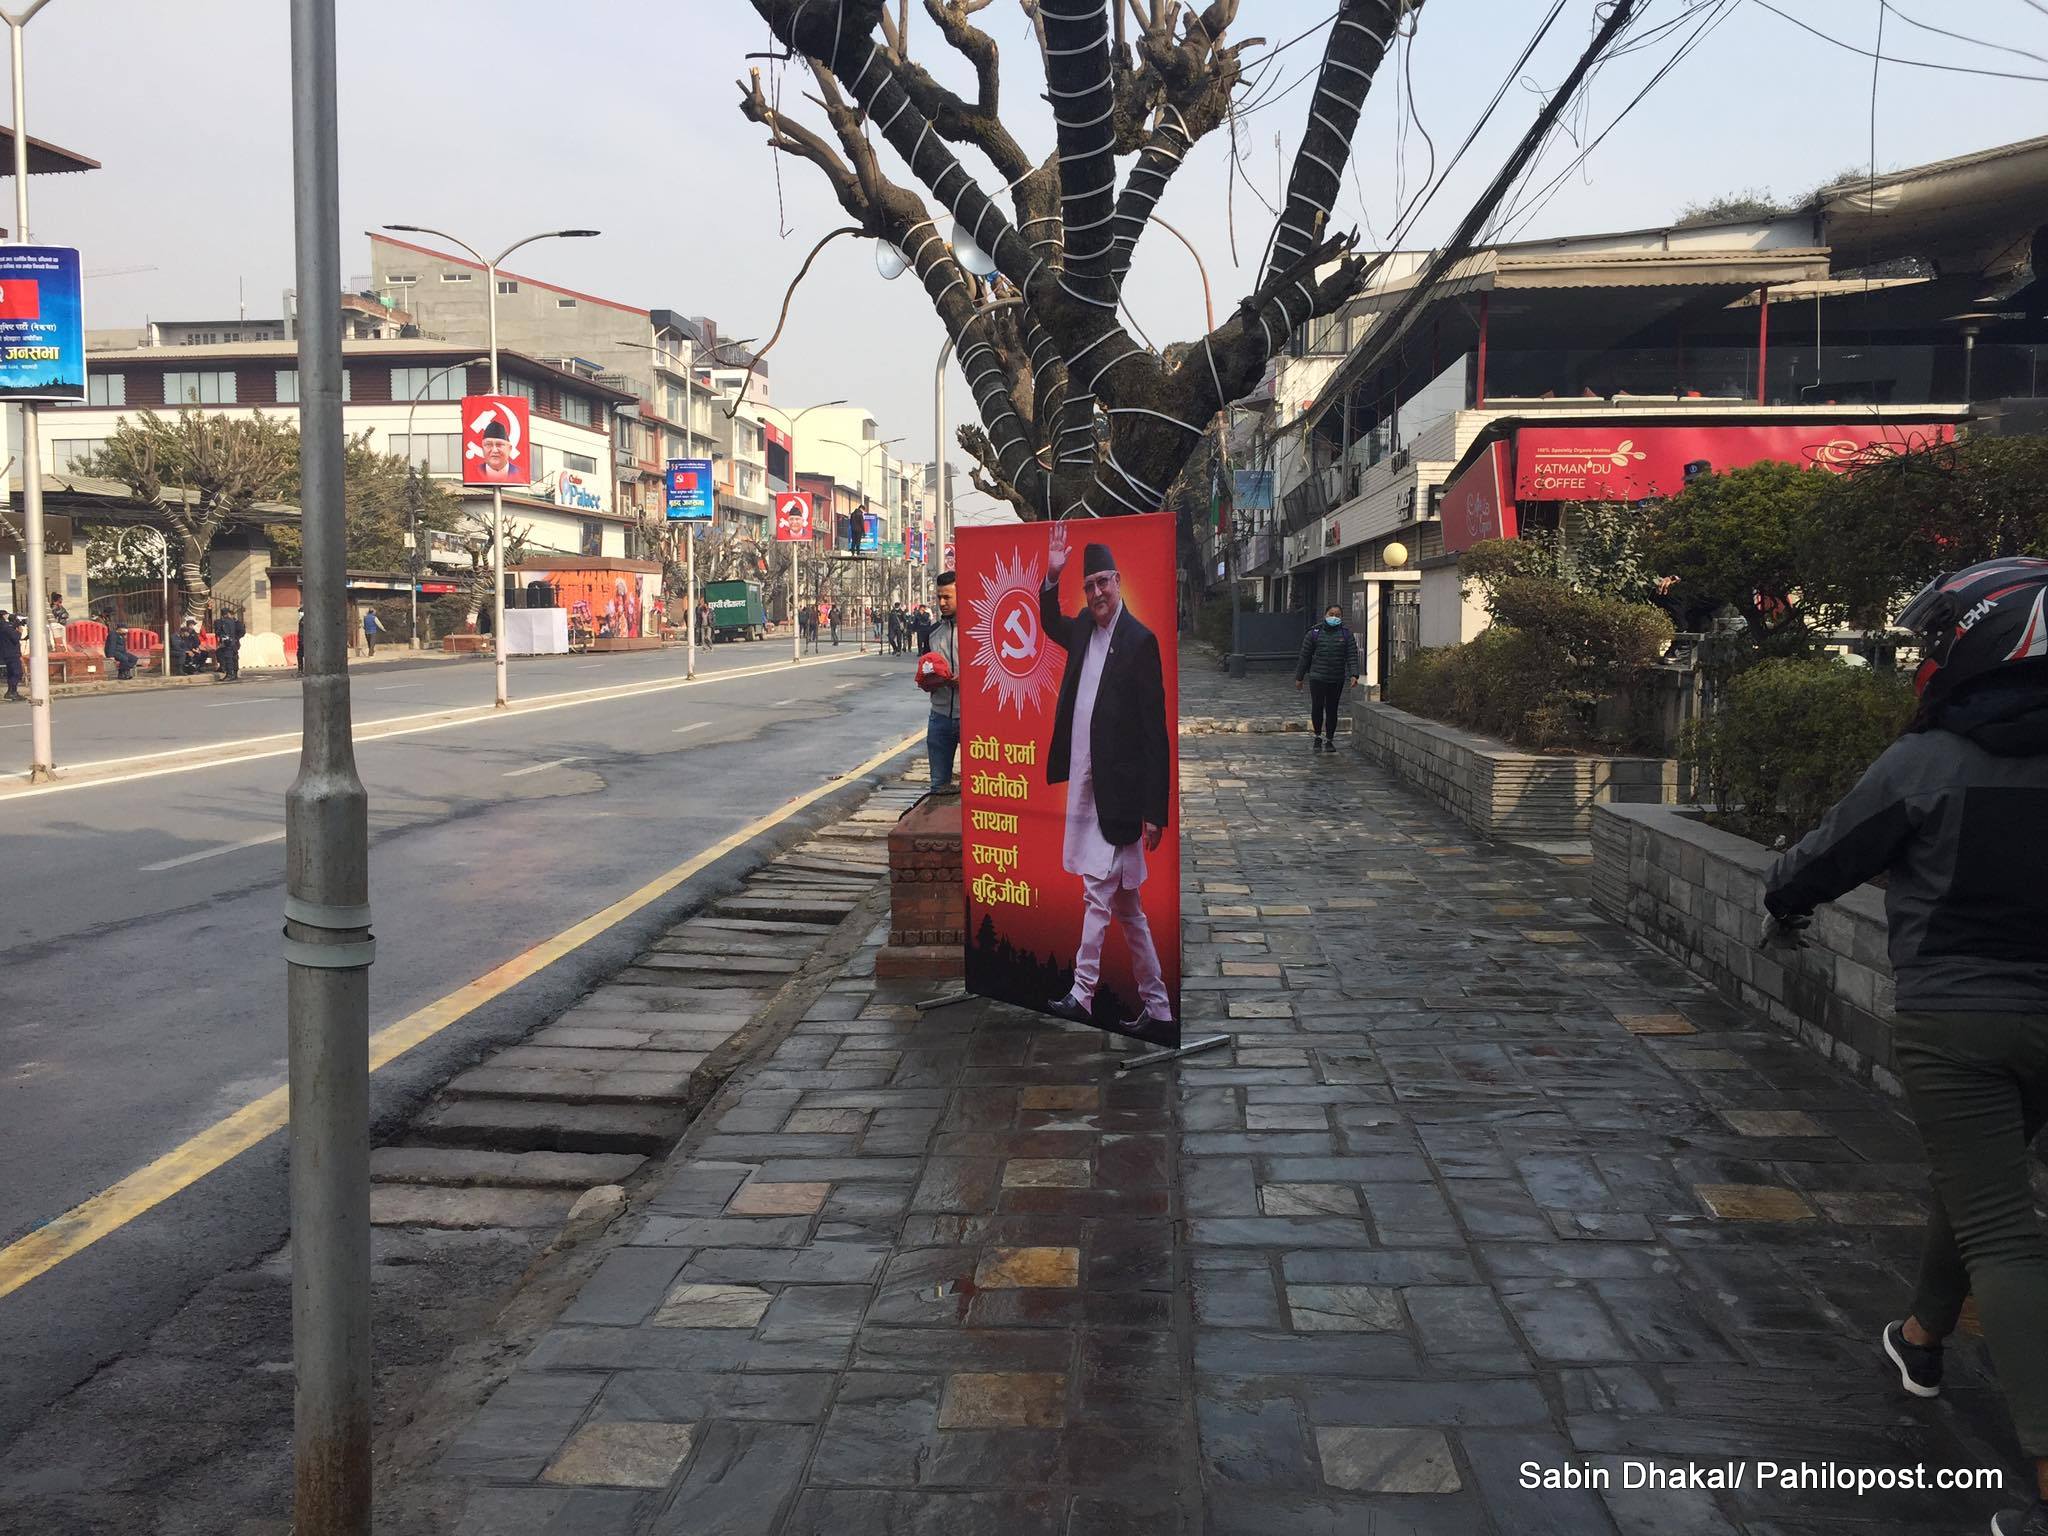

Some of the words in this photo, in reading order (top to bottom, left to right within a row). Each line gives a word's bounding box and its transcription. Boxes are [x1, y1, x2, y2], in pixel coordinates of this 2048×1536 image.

[5, 346, 60, 360] जनसभा
[1534, 477, 1586, 489] COFFEE
[969, 735, 1000, 762] केपी
[1004, 740, 1036, 765] शर्मा
[970, 770, 1029, 800] ओलीको
[971, 809, 1018, 834] साथमा
[972, 843, 1018, 873] सम्पूर्ण
[972, 873, 1030, 907] बुद्धिजीवी
